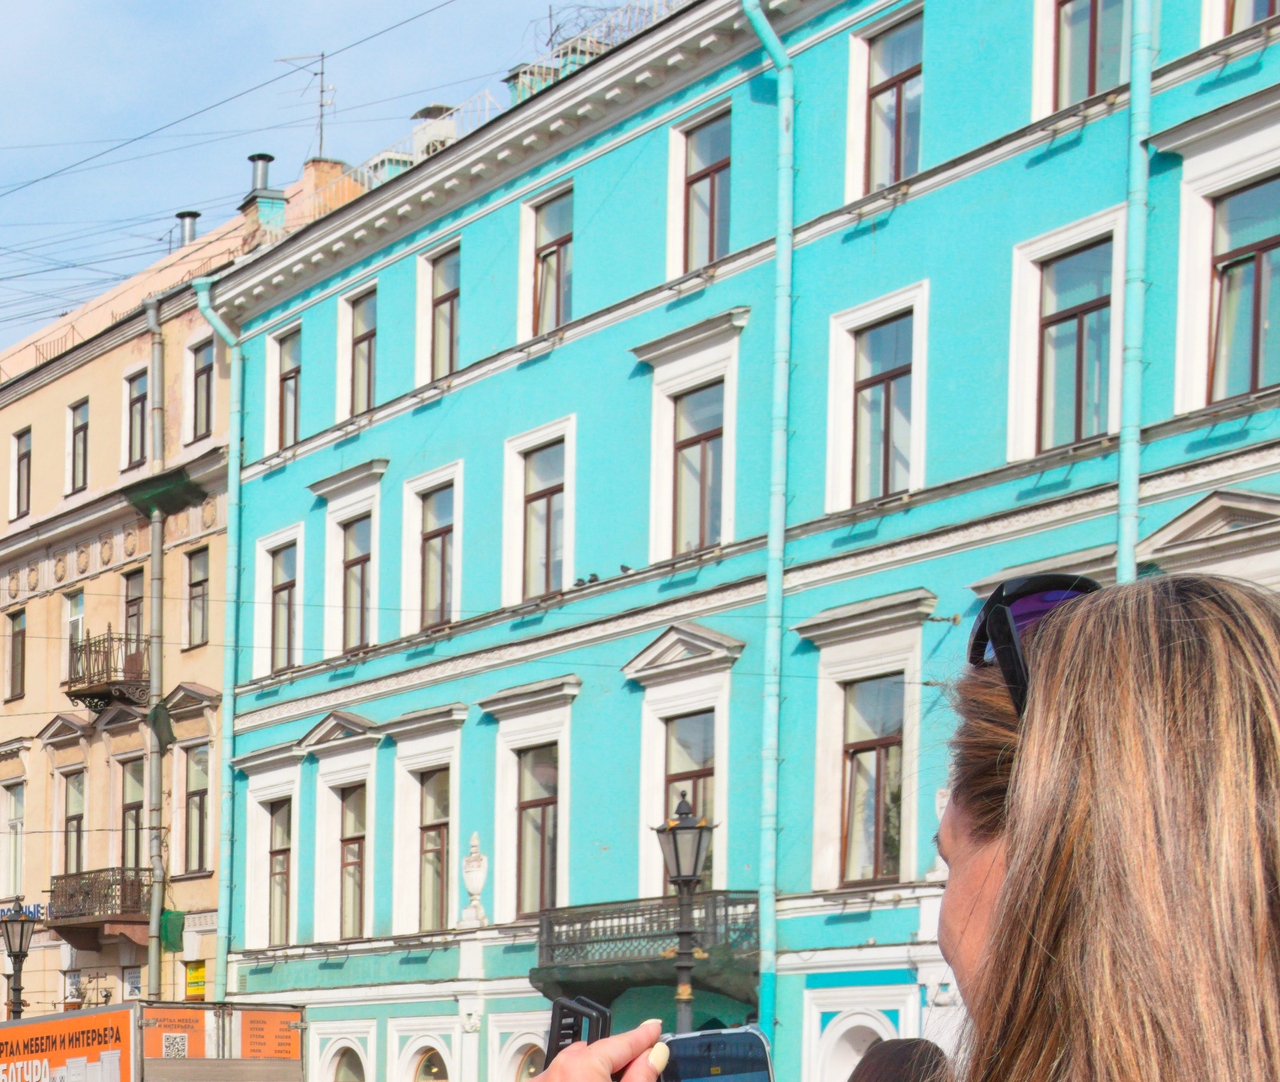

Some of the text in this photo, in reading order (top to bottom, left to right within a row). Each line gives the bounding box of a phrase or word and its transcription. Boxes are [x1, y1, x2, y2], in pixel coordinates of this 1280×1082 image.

[23, 1035, 57, 1055] МЕБЕЛИ
[59, 1033, 66, 1051] И
[68, 1026, 121, 1049] ИНТЕРЬЕРА
